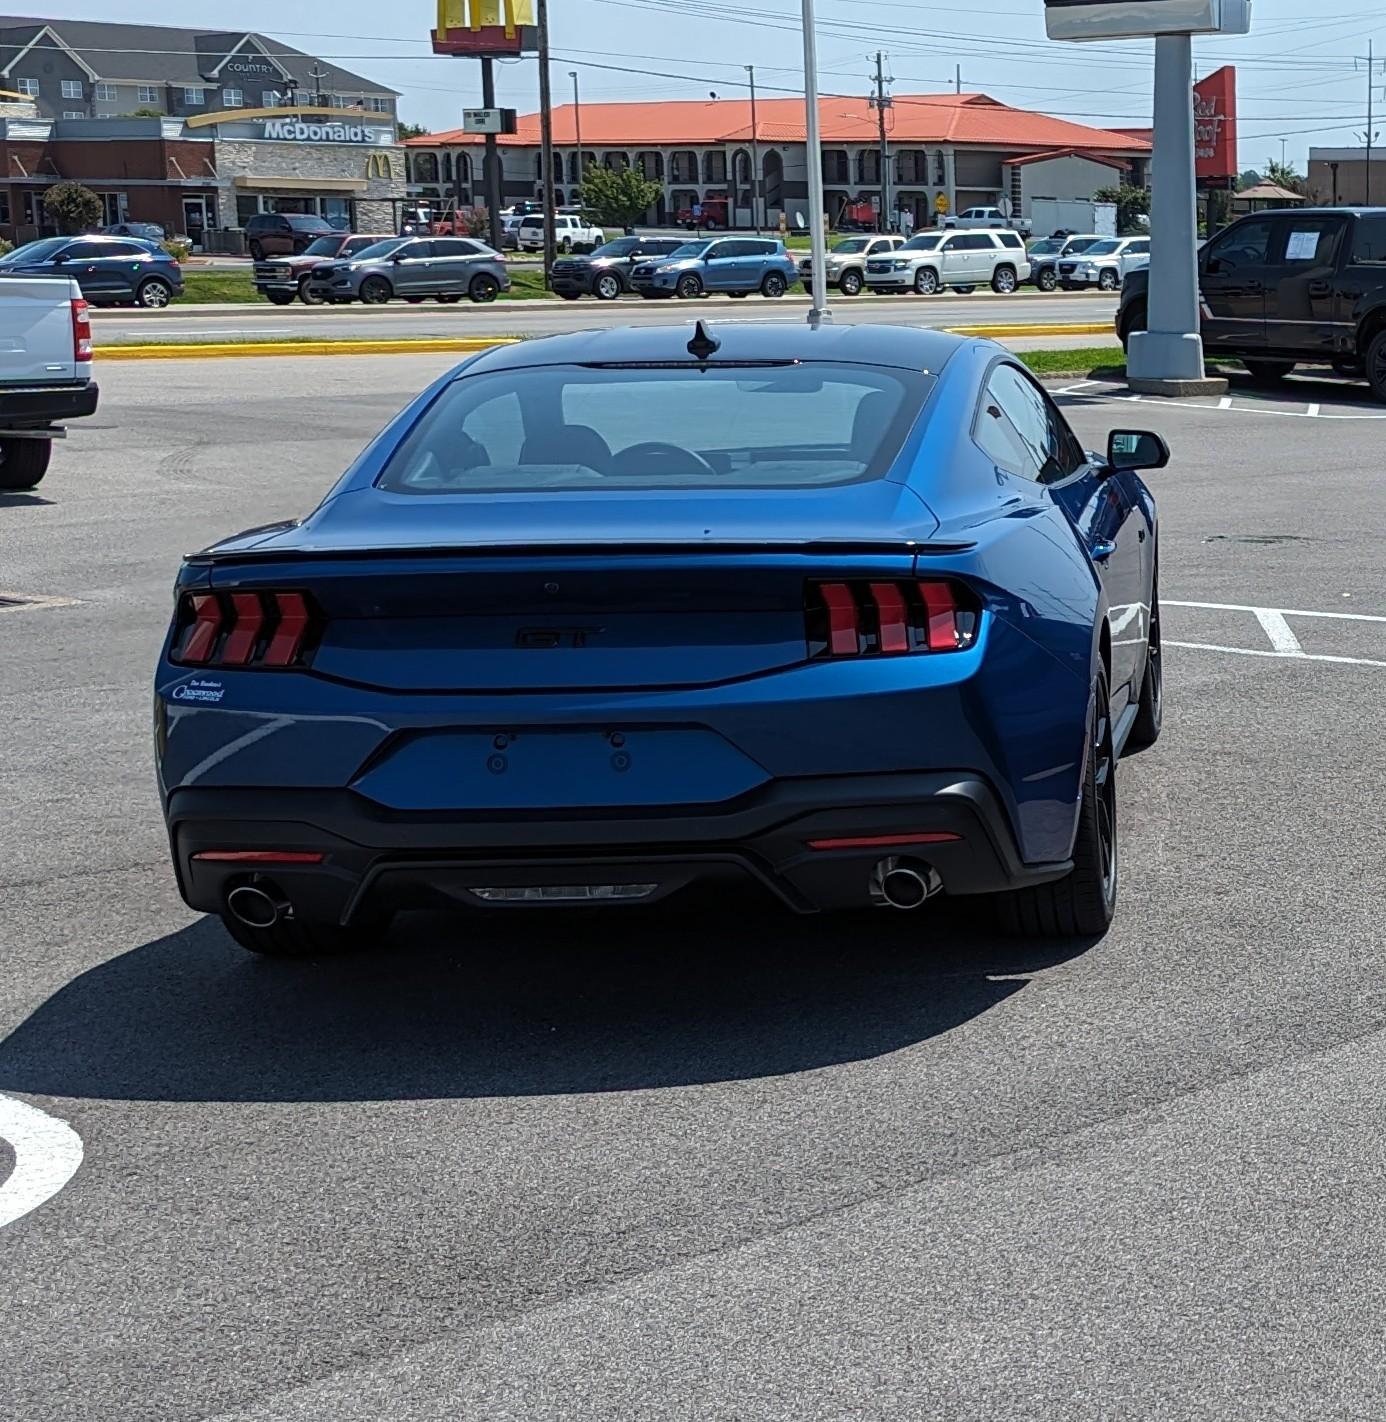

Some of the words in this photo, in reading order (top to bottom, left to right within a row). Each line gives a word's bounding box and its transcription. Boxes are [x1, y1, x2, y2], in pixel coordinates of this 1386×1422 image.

[227, 63, 273, 73] COUNTRY
[263, 121, 375, 142] McDonald's
[1194, 119, 1221, 146] oof
